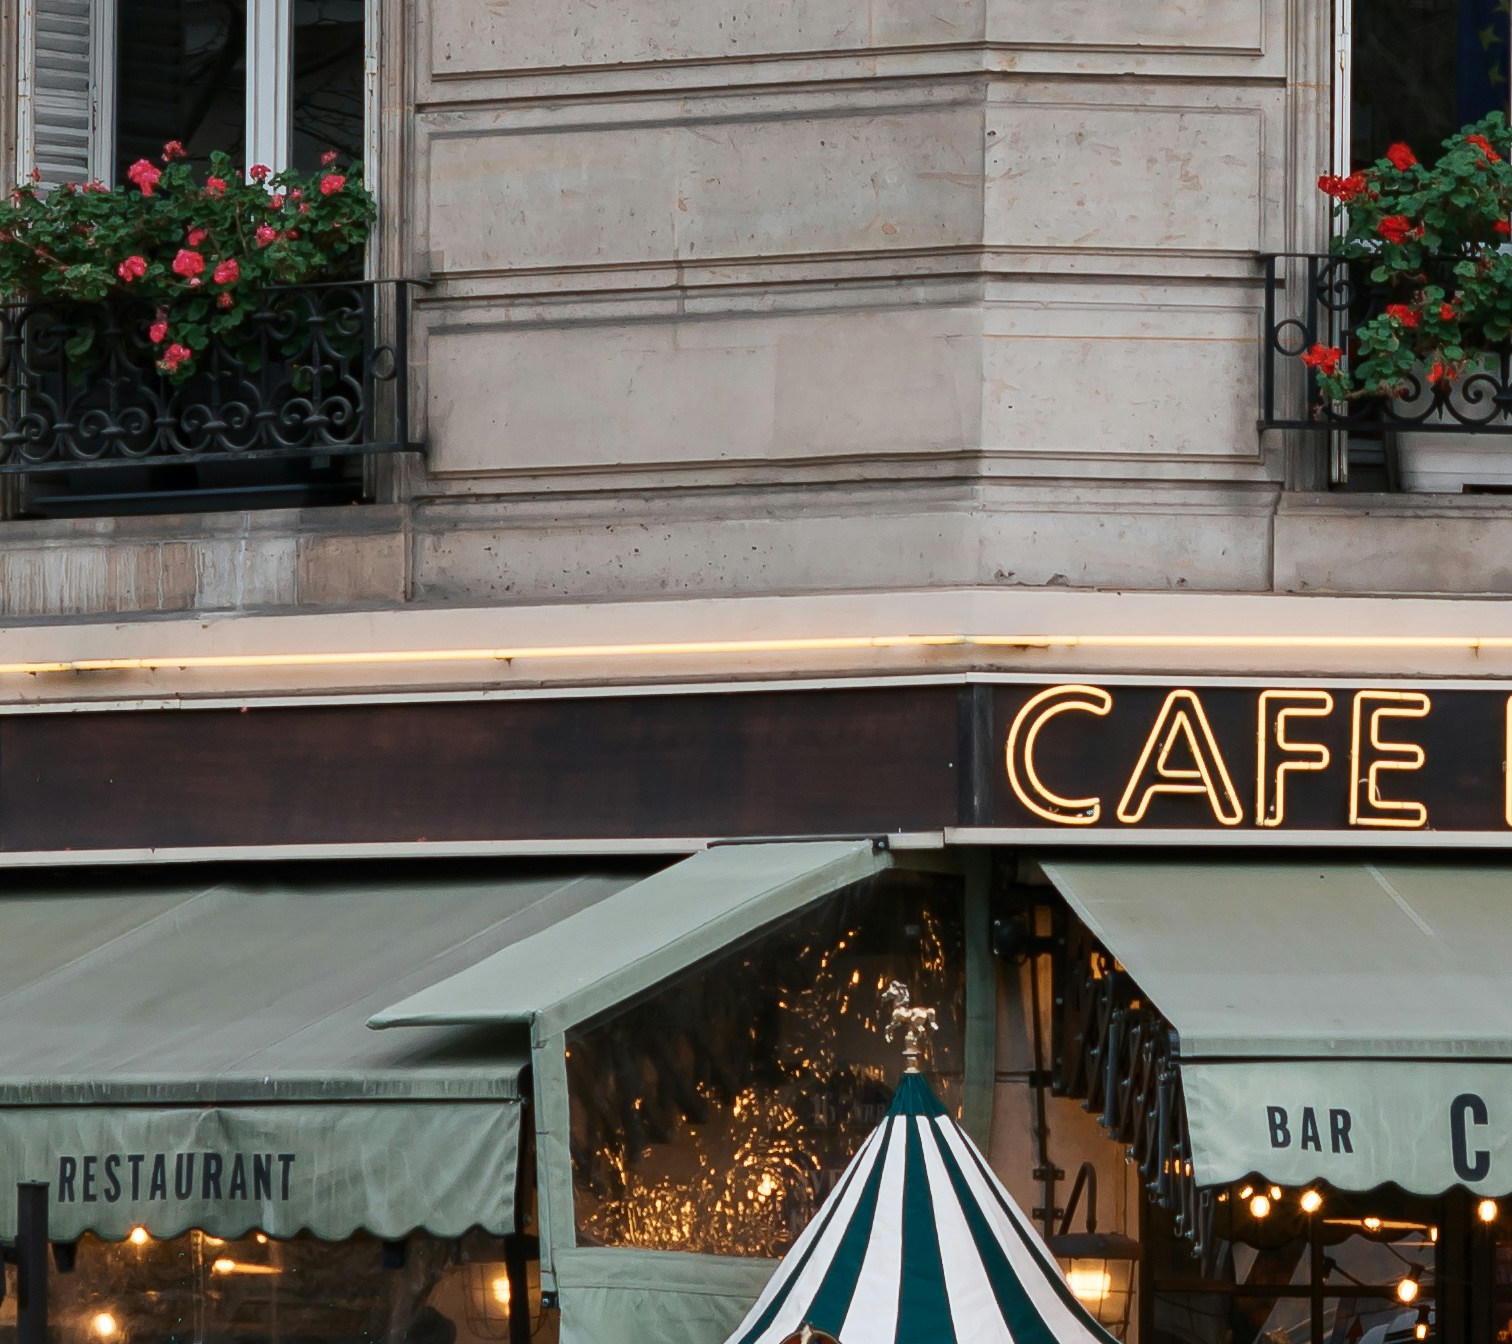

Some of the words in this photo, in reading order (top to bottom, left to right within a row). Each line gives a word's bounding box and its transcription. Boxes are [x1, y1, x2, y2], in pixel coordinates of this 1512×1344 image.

[1005, 684, 1432, 828] CAFE
[1266, 1106, 1355, 1154] BAR
[58, 1152, 296, 1203] RESTAURANT
